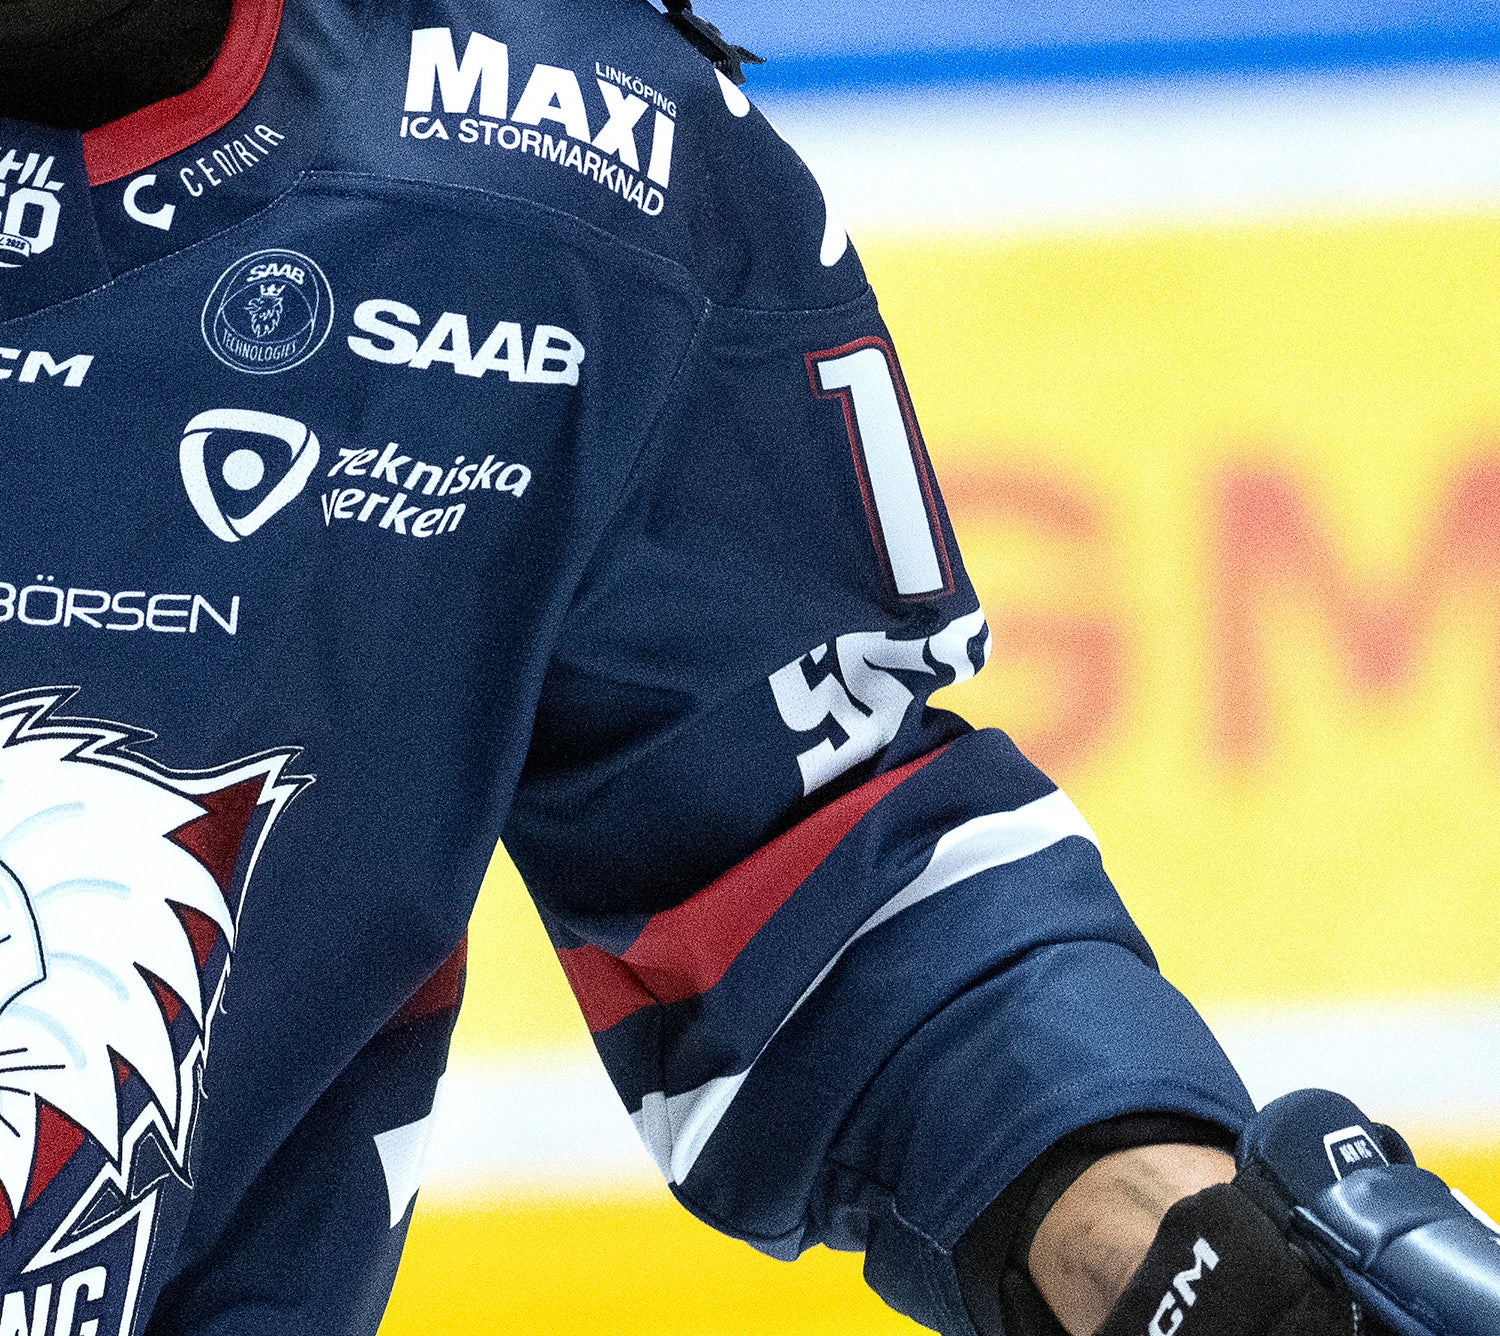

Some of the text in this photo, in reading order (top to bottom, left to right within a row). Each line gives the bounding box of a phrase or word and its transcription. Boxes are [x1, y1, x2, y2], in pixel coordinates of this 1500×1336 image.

[403, 26, 676, 190] MAXI
[594, 61, 677, 118] LINKÖPING
[179, 124, 285, 198] CENTRIA
[399, 115, 665, 216] ICA STORMARKNAD
[246, 263, 306, 286] SAAB
[347, 298, 586, 387] SAAB
[327, 441, 533, 498] Tekniska
